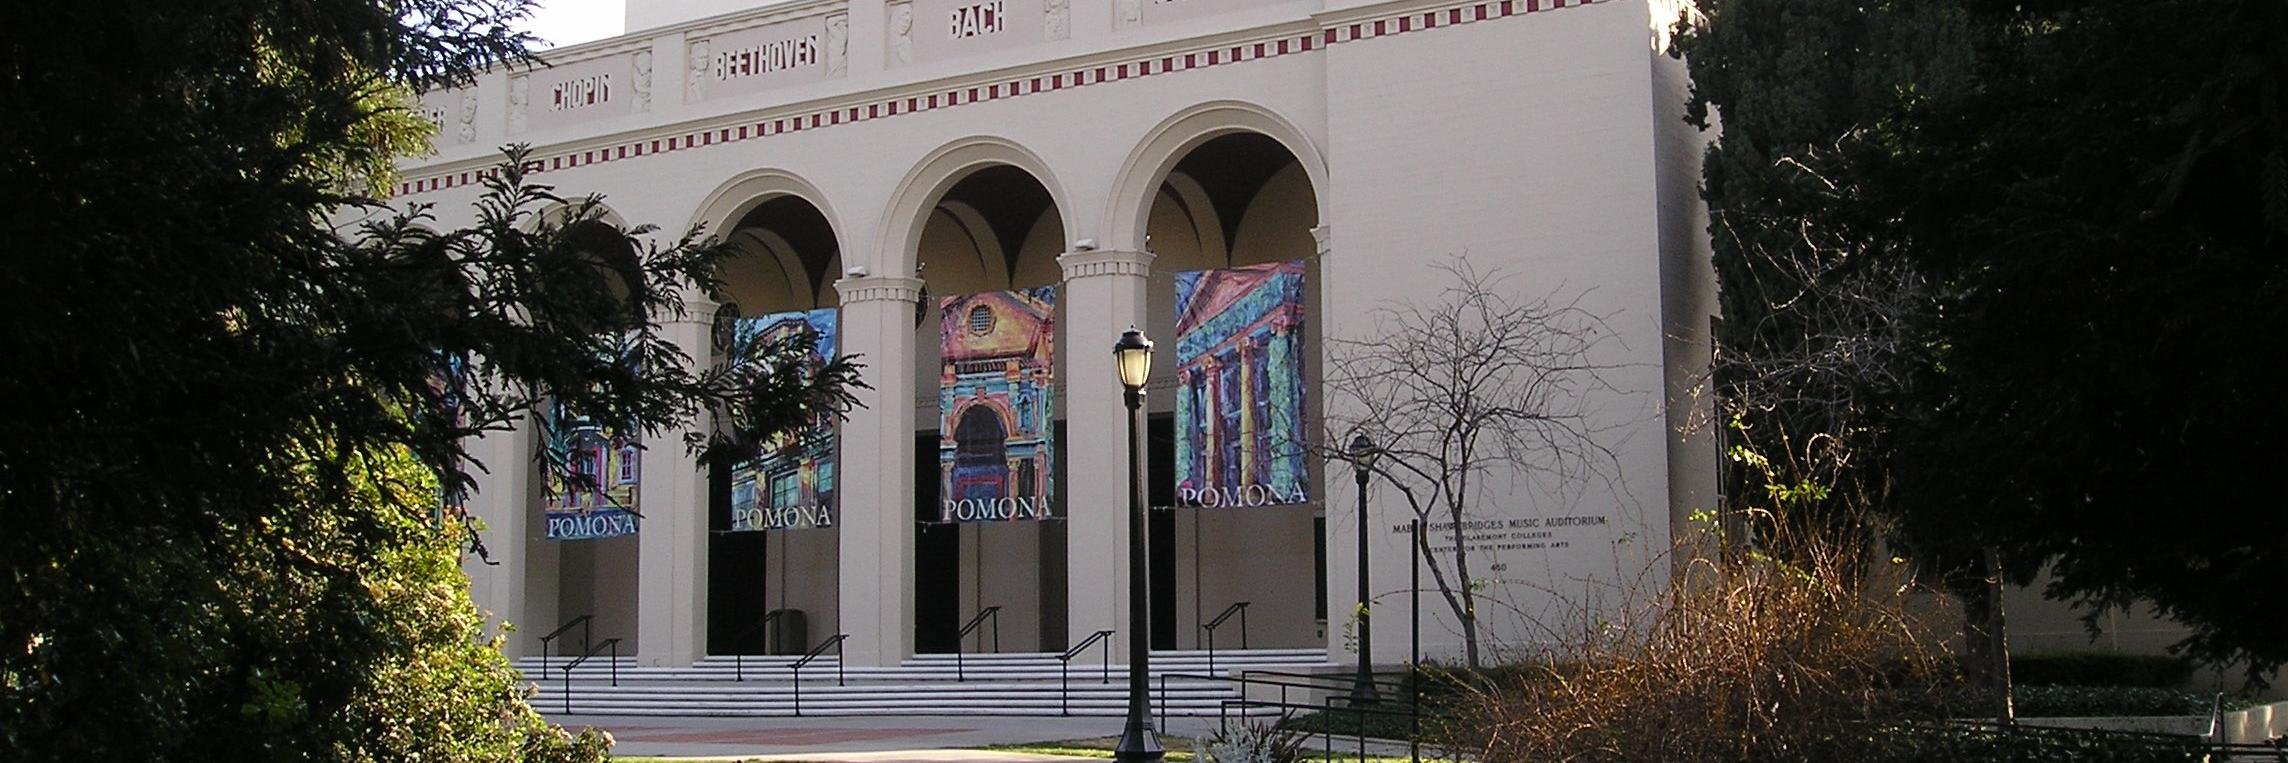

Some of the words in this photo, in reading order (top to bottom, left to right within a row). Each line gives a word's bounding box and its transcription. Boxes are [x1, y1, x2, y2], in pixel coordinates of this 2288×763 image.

[951, 1, 1003, 38] BACH
[716, 35, 818, 80] BEETHOVEN
[550, 73, 612, 112] CHOPIN
[1181, 480, 1307, 508] POMONA
[735, 504, 831, 530] POMONA
[942, 495, 1052, 521] POMONA
[547, 514, 636, 539] POMONA
[1462, 519, 1504, 531] BRIDGES
[1509, 518, 1540, 529] MUSIC
[1545, 515, 1606, 528] AUDITORIUM
